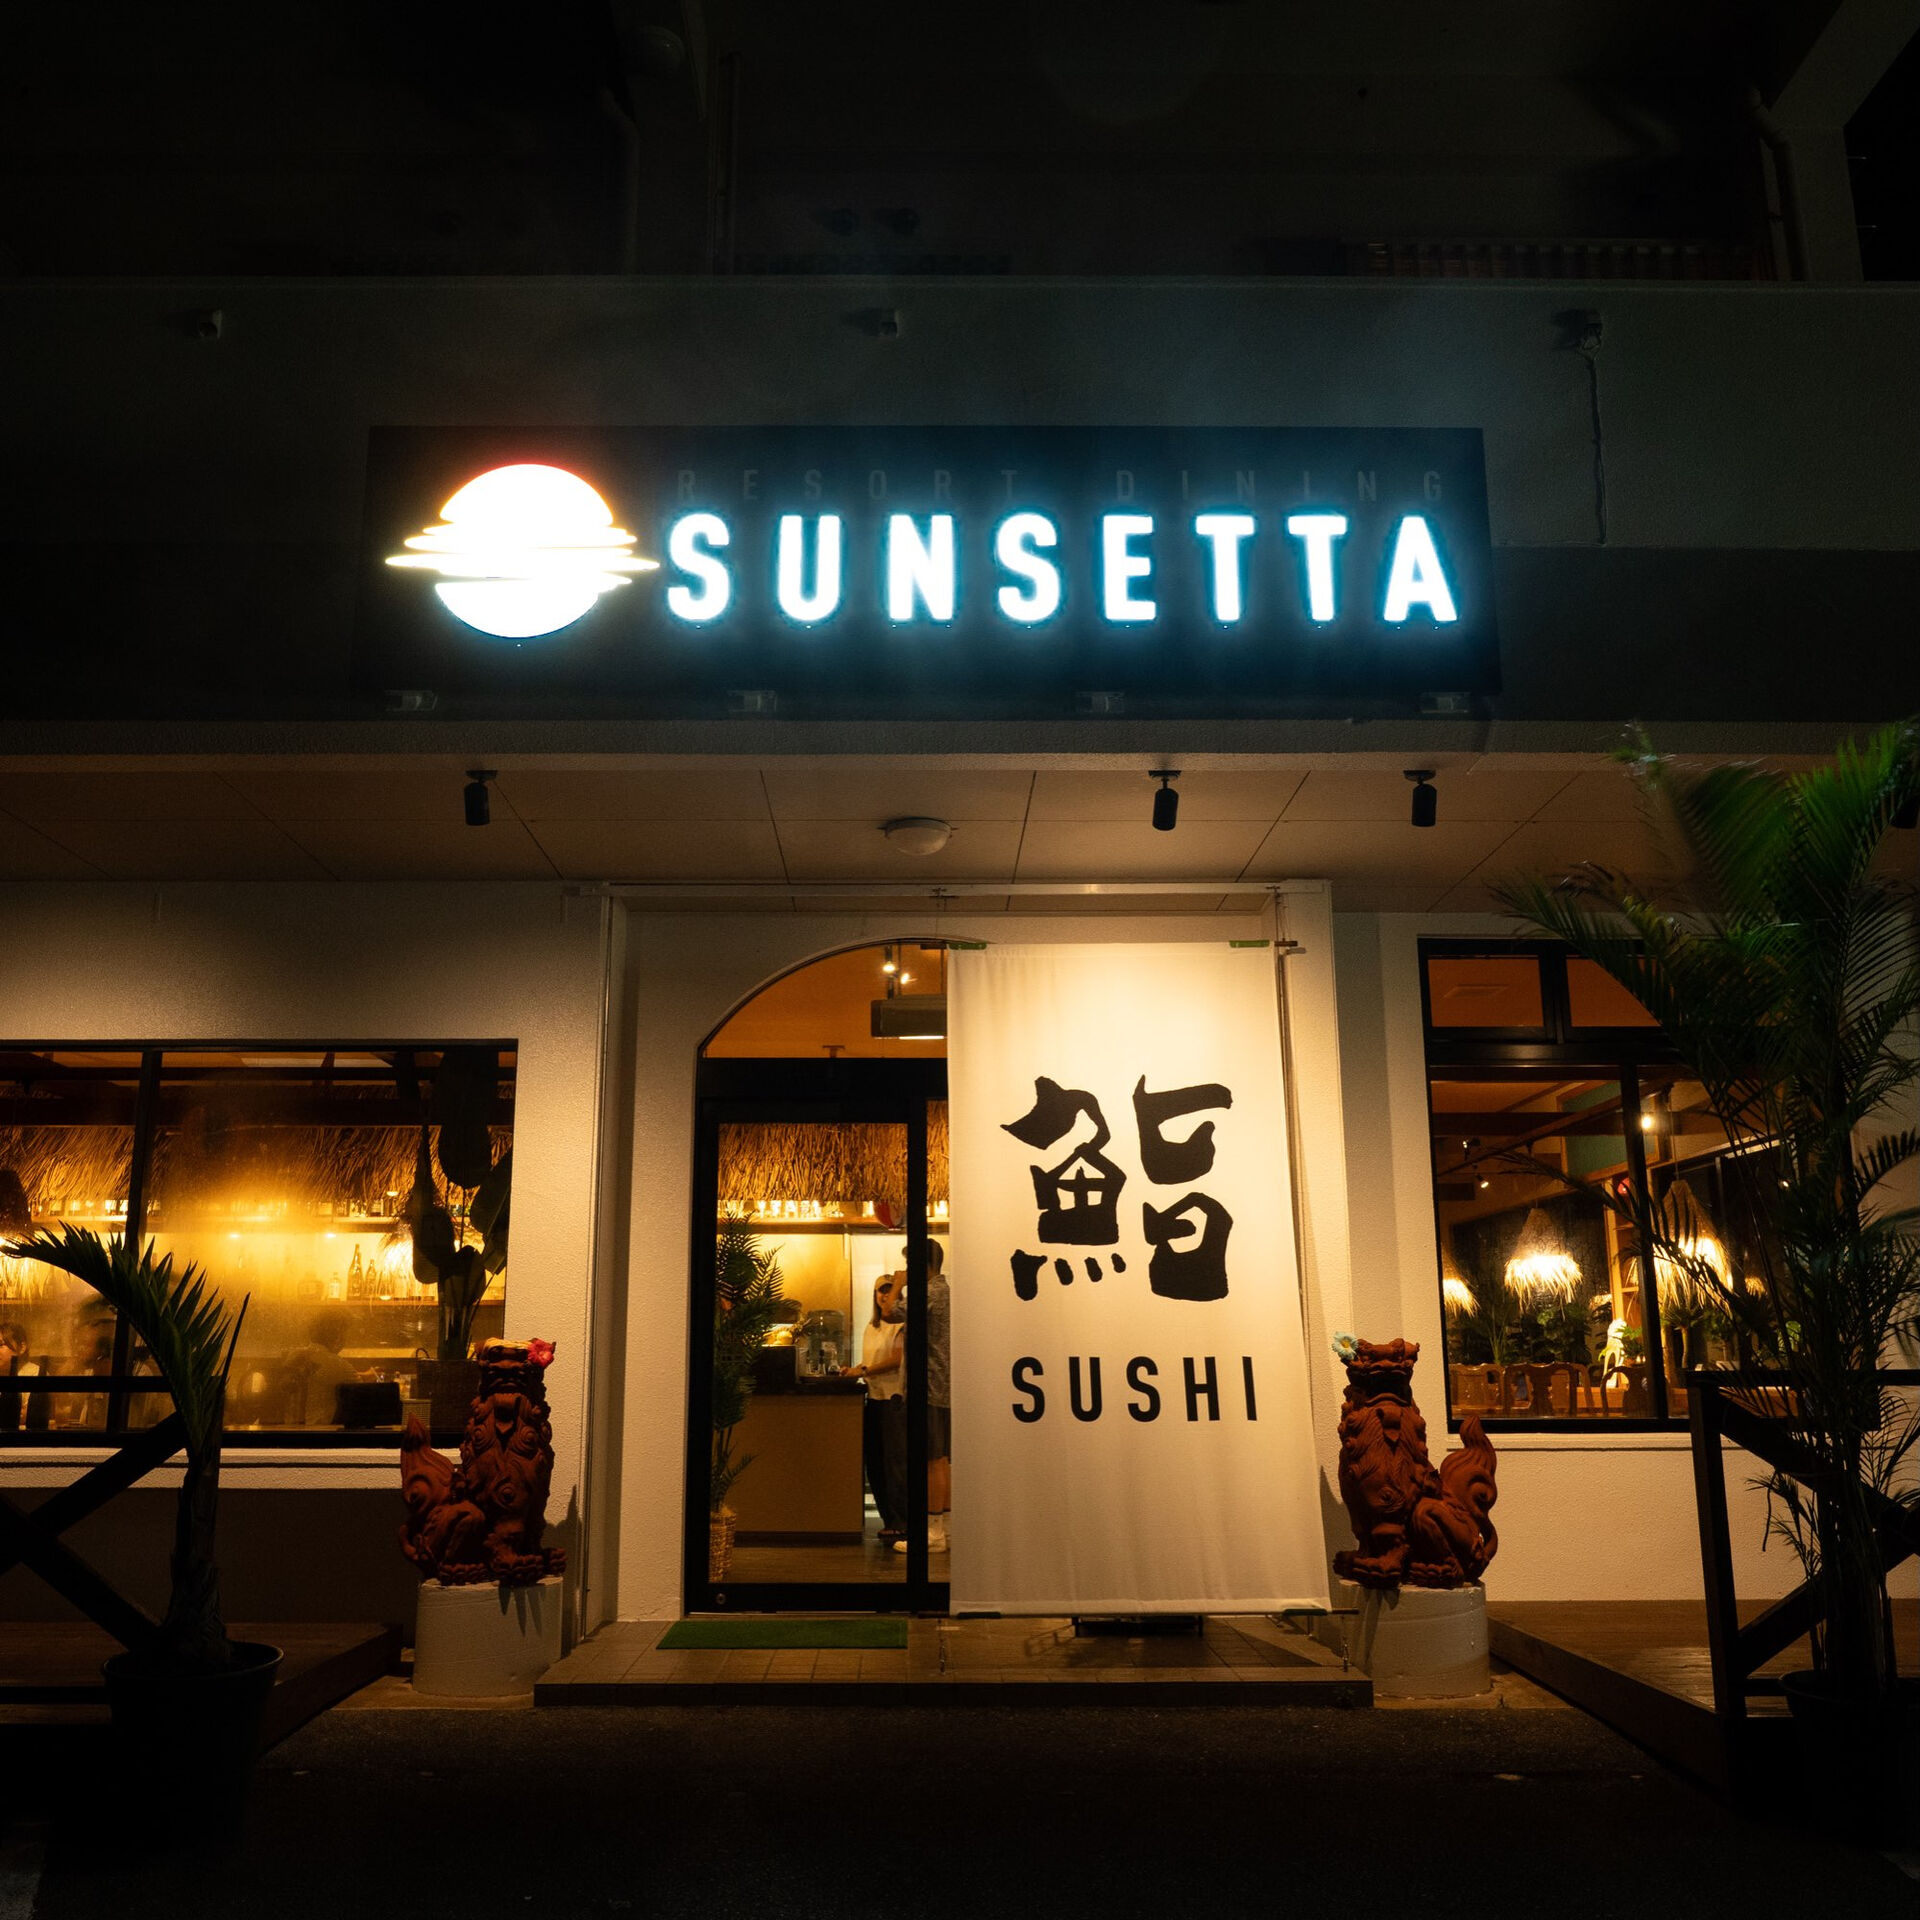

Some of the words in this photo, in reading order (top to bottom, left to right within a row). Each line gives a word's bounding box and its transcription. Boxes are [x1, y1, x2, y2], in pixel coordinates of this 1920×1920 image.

[677, 469, 1019, 501] RESORT
[1116, 469, 1443, 501] DINING
[666, 511, 1459, 623] SUNSETTA
[1000, 1074, 1233, 1301] 鮨
[1011, 1356, 1258, 1423] SUSHI
